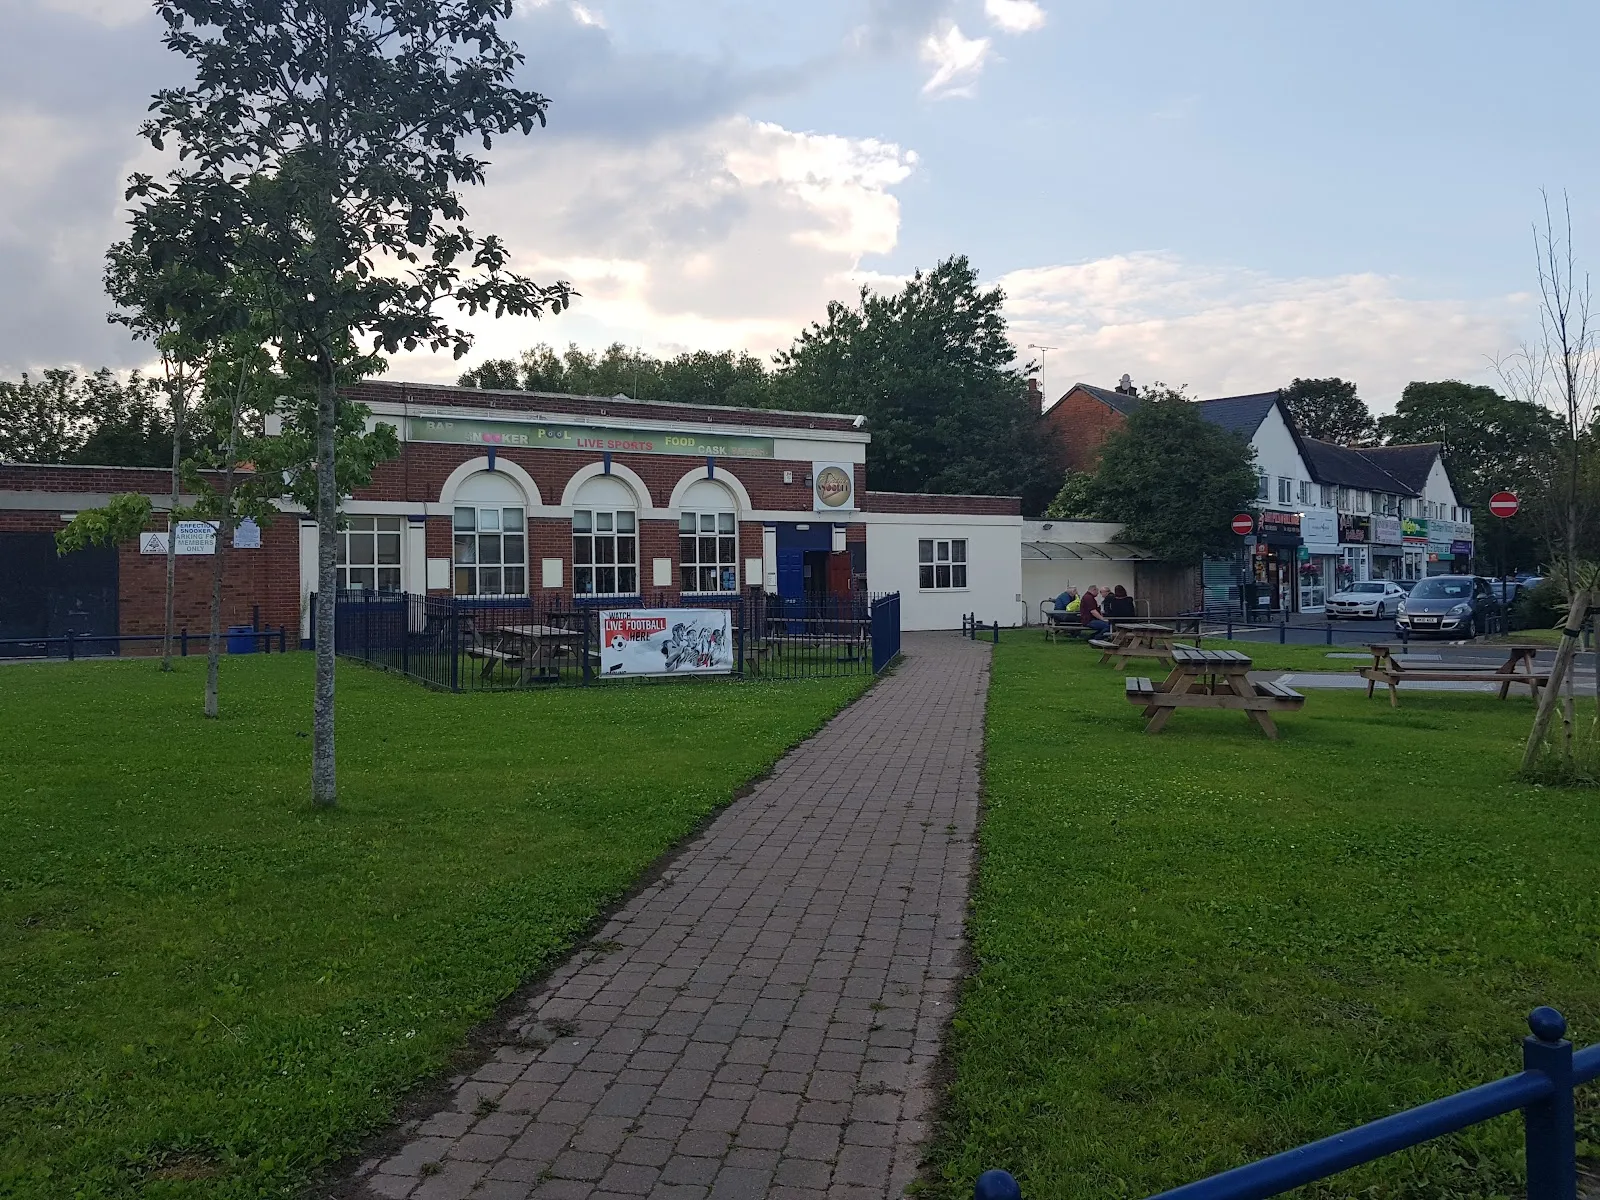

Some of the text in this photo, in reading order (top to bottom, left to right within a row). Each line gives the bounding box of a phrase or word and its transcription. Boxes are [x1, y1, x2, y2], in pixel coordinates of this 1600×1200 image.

[465, 431, 529, 445] SNOOKER
[538, 428, 572, 440] POOL
[577, 438, 653, 451] LIVE SPORTS
[665, 436, 695, 447] FOOD
[698, 444, 727, 455] CASK
[609, 611, 631, 620] WATCH
[605, 619, 666, 631] LIVE FOOTBALL
[629, 631, 651, 642] HERE
